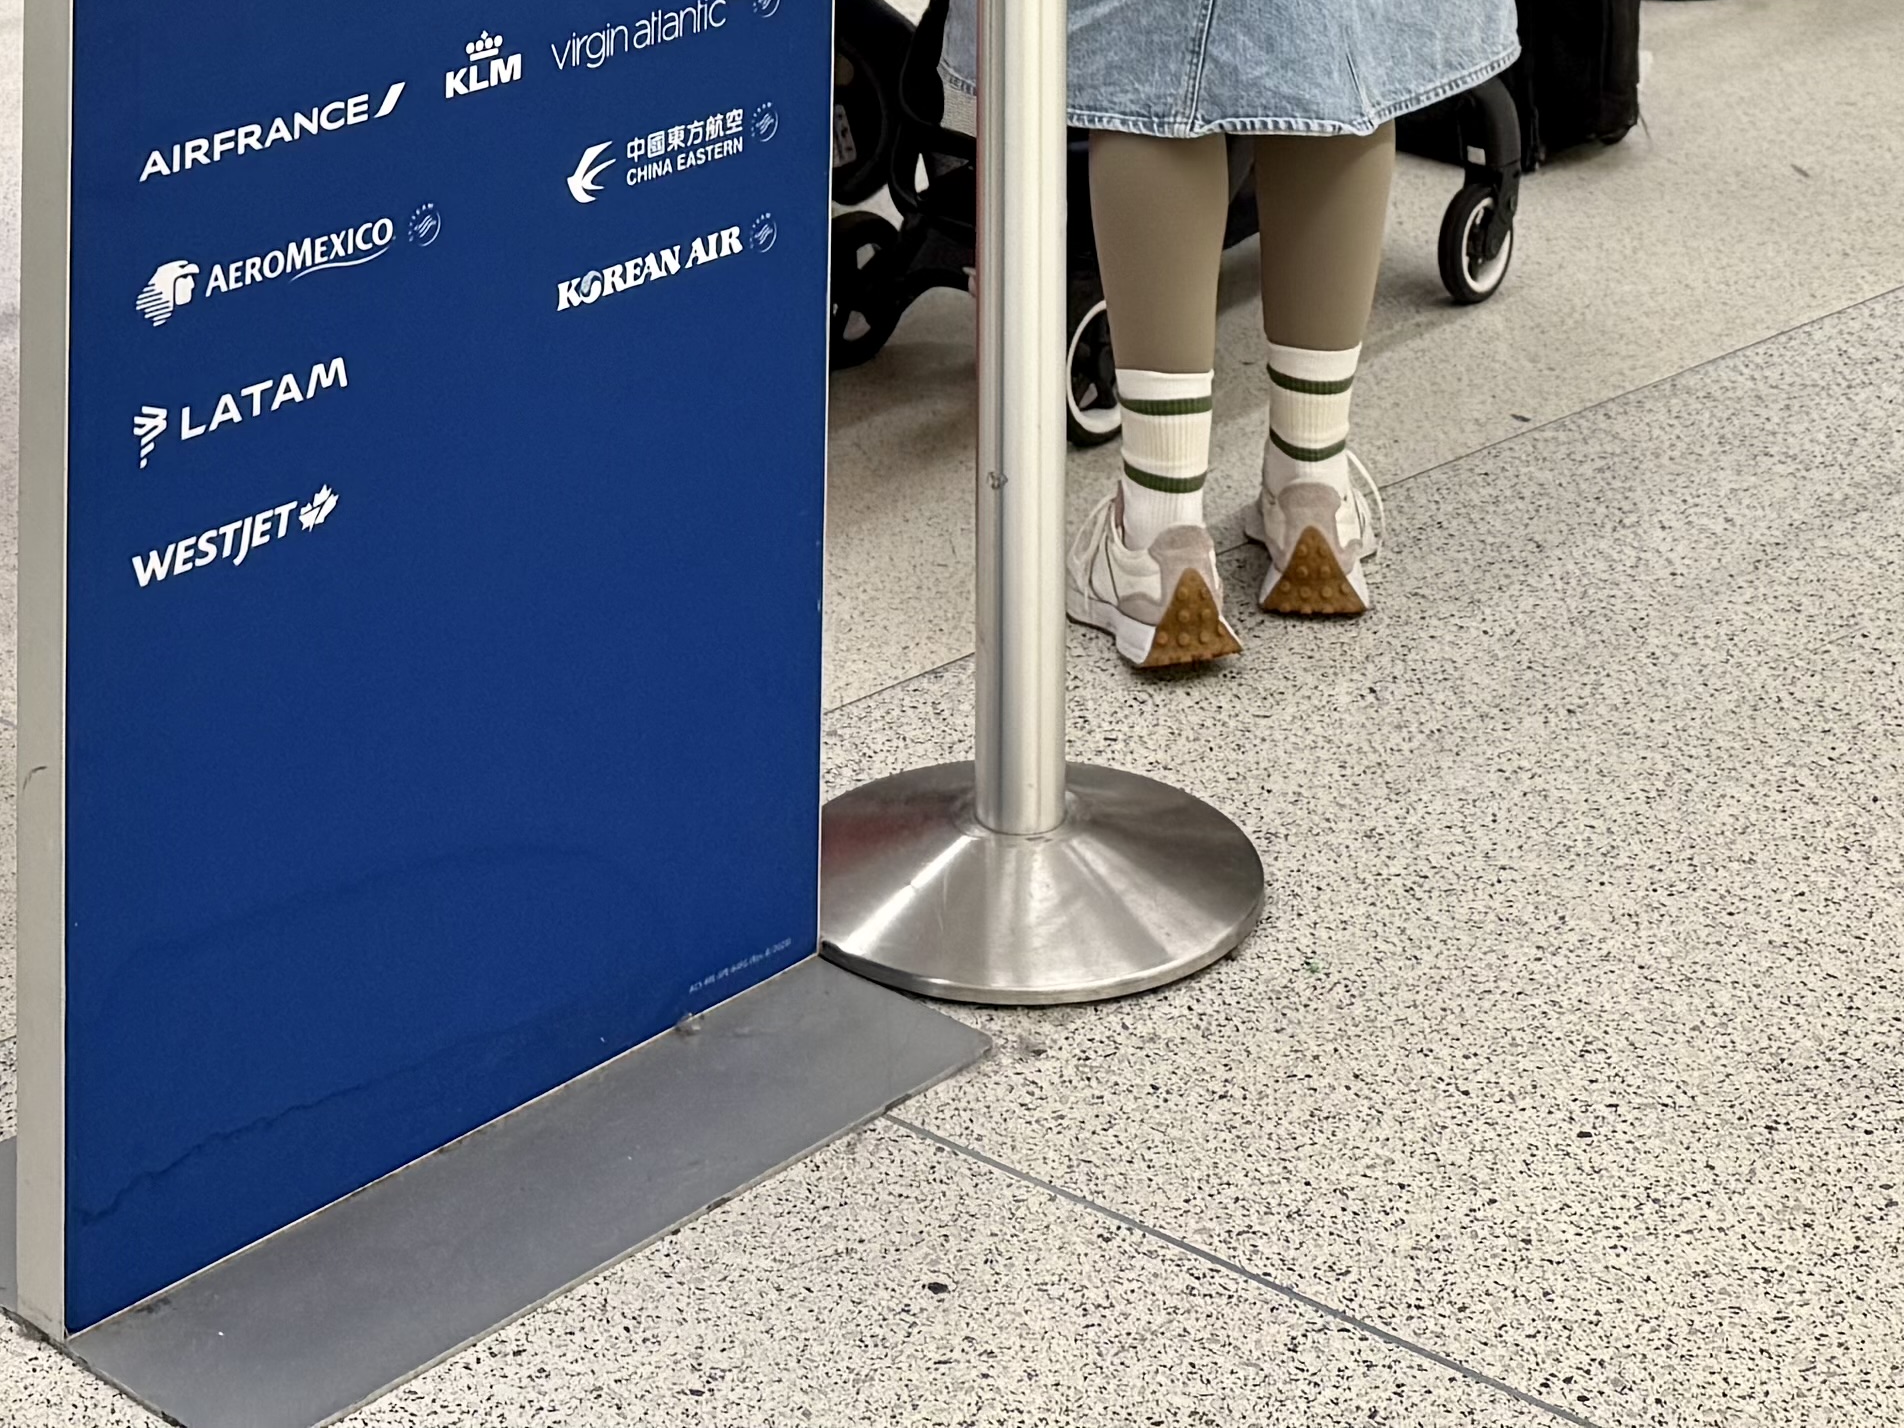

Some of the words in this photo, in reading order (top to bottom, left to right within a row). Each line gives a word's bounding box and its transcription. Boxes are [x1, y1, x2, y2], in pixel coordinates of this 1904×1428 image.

[552, 23, 628, 69] virgin
[446, 53, 521, 98] KLM
[627, 109, 743, 162] 中國東方航空
[627, 159, 672, 185] CHINA
[677, 137, 742, 170] EASTERN
[557, 245, 680, 311] KOREAN
[685, 227, 742, 268] AIR
[182, 358, 347, 440] LATAM
[132, 501, 297, 586] WESTJET
